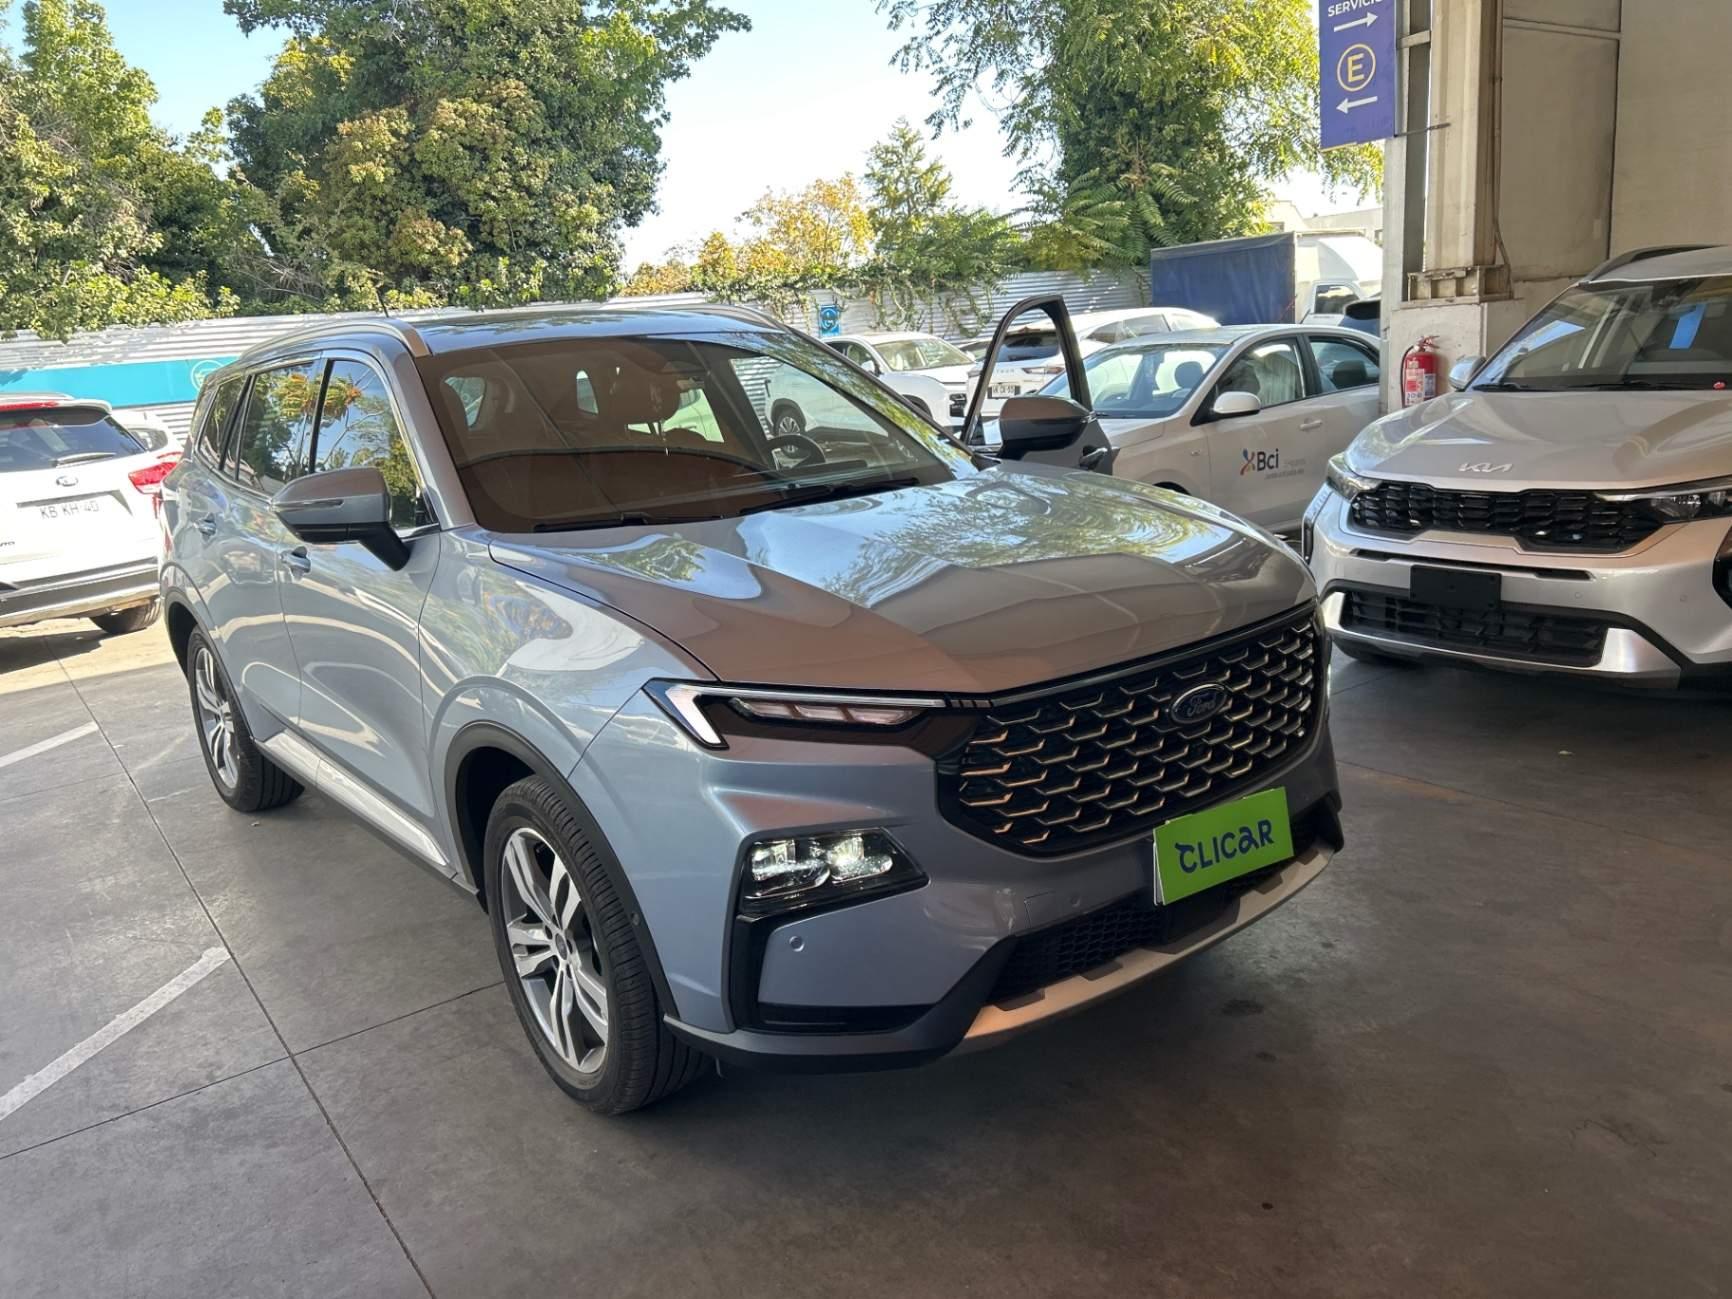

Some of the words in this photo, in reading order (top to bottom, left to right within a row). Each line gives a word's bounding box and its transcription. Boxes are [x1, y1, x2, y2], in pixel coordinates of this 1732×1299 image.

[1328, 0, 1383, 17] SERVIC
[1347, 53, 1365, 83] E
[1256, 448, 1279, 472] Bci
